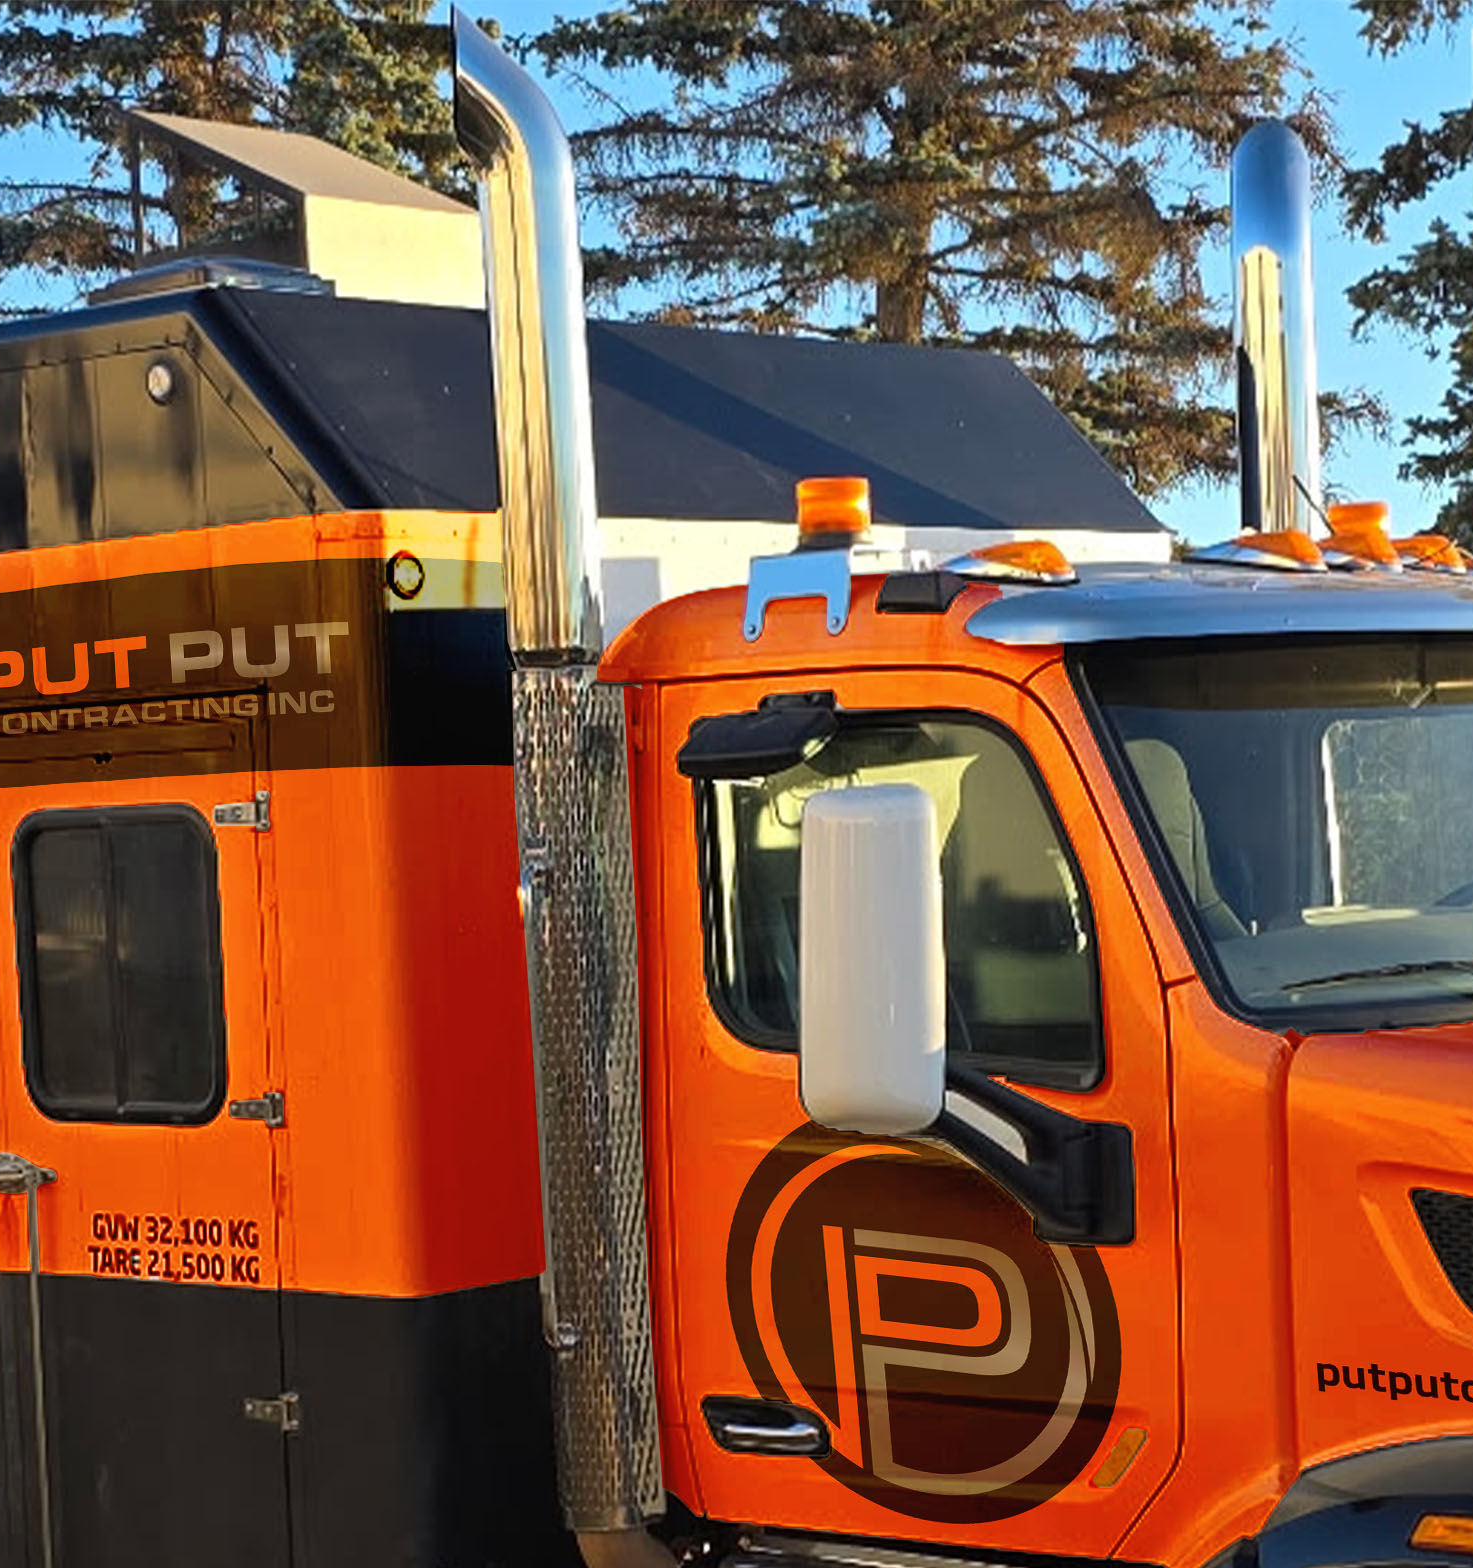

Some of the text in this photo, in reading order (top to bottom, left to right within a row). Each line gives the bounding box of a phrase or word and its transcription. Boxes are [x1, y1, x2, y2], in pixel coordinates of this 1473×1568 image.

[169, 622, 350, 684] PUT
[266, 690, 335, 716] INC
[92, 1213, 259, 1250] GVW 32,100 KG
[88, 1246, 260, 1283] TARE 21,500 KG
